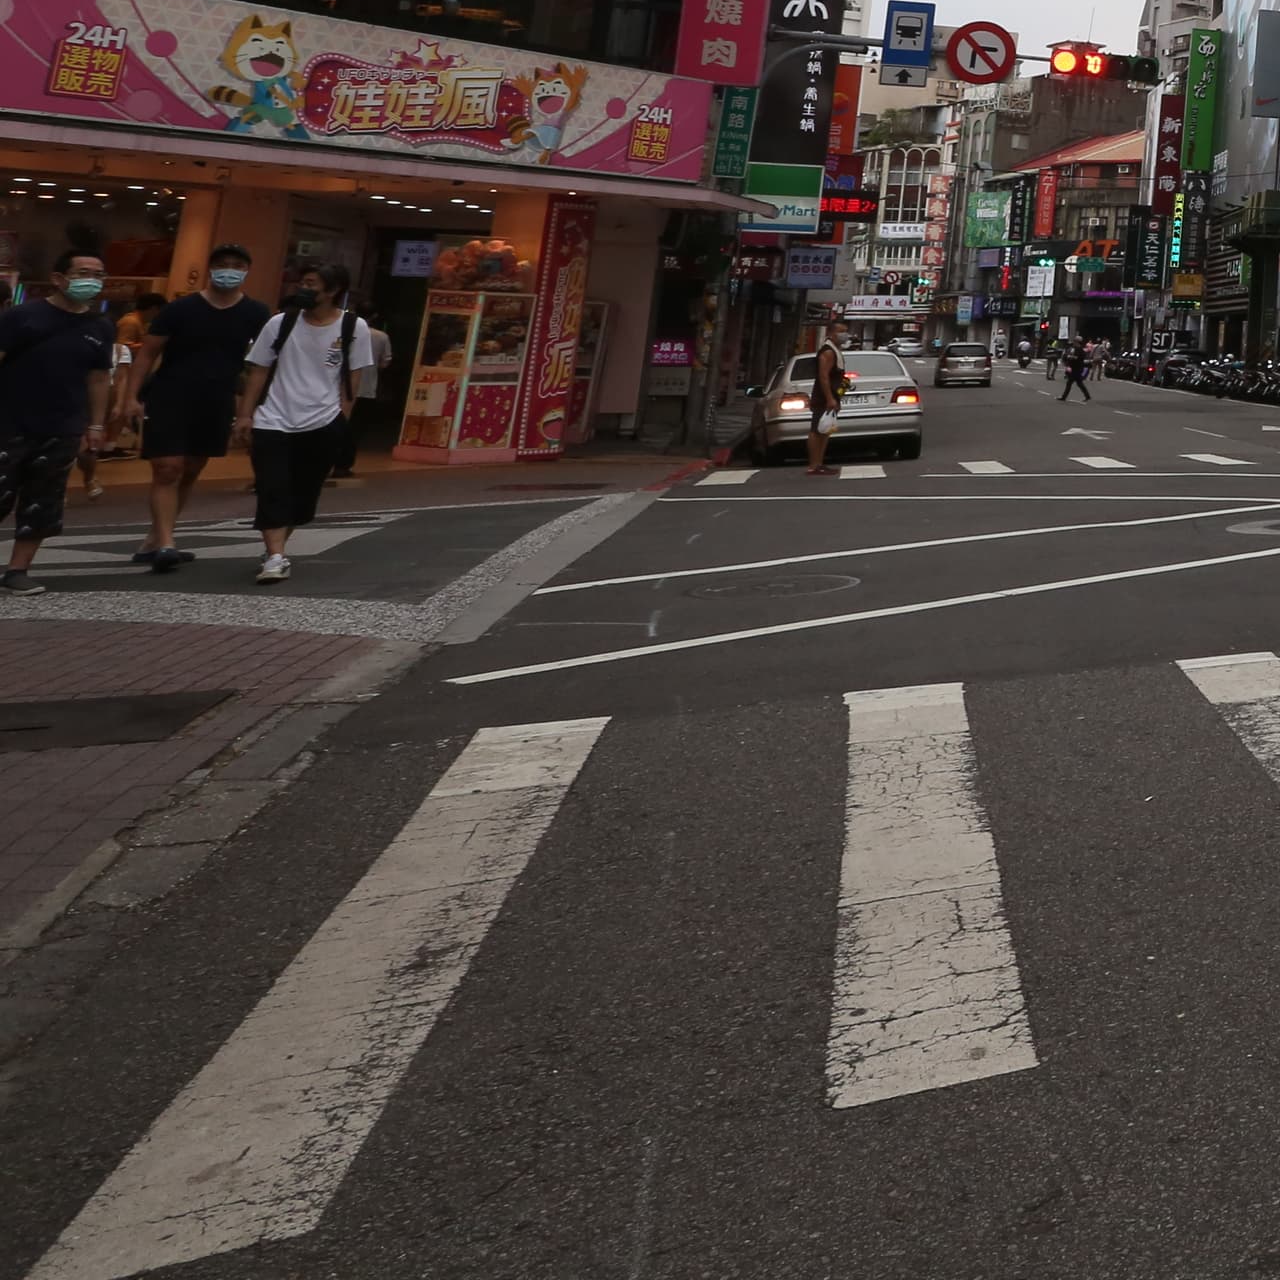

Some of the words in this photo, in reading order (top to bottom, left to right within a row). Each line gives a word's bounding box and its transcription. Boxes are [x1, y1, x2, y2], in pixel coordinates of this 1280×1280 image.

[64, 22, 127, 50] 24H
[60, 45, 120, 73] 選物
[54, 70, 116, 97] 販売
[330, 68, 504, 133] 娃娃瘋
[639, 104, 673, 125] 24H
[633, 124, 669, 143] 選物
[1158, 116, 1183, 192] 新東陽
[776, 204, 816, 219] yMart
